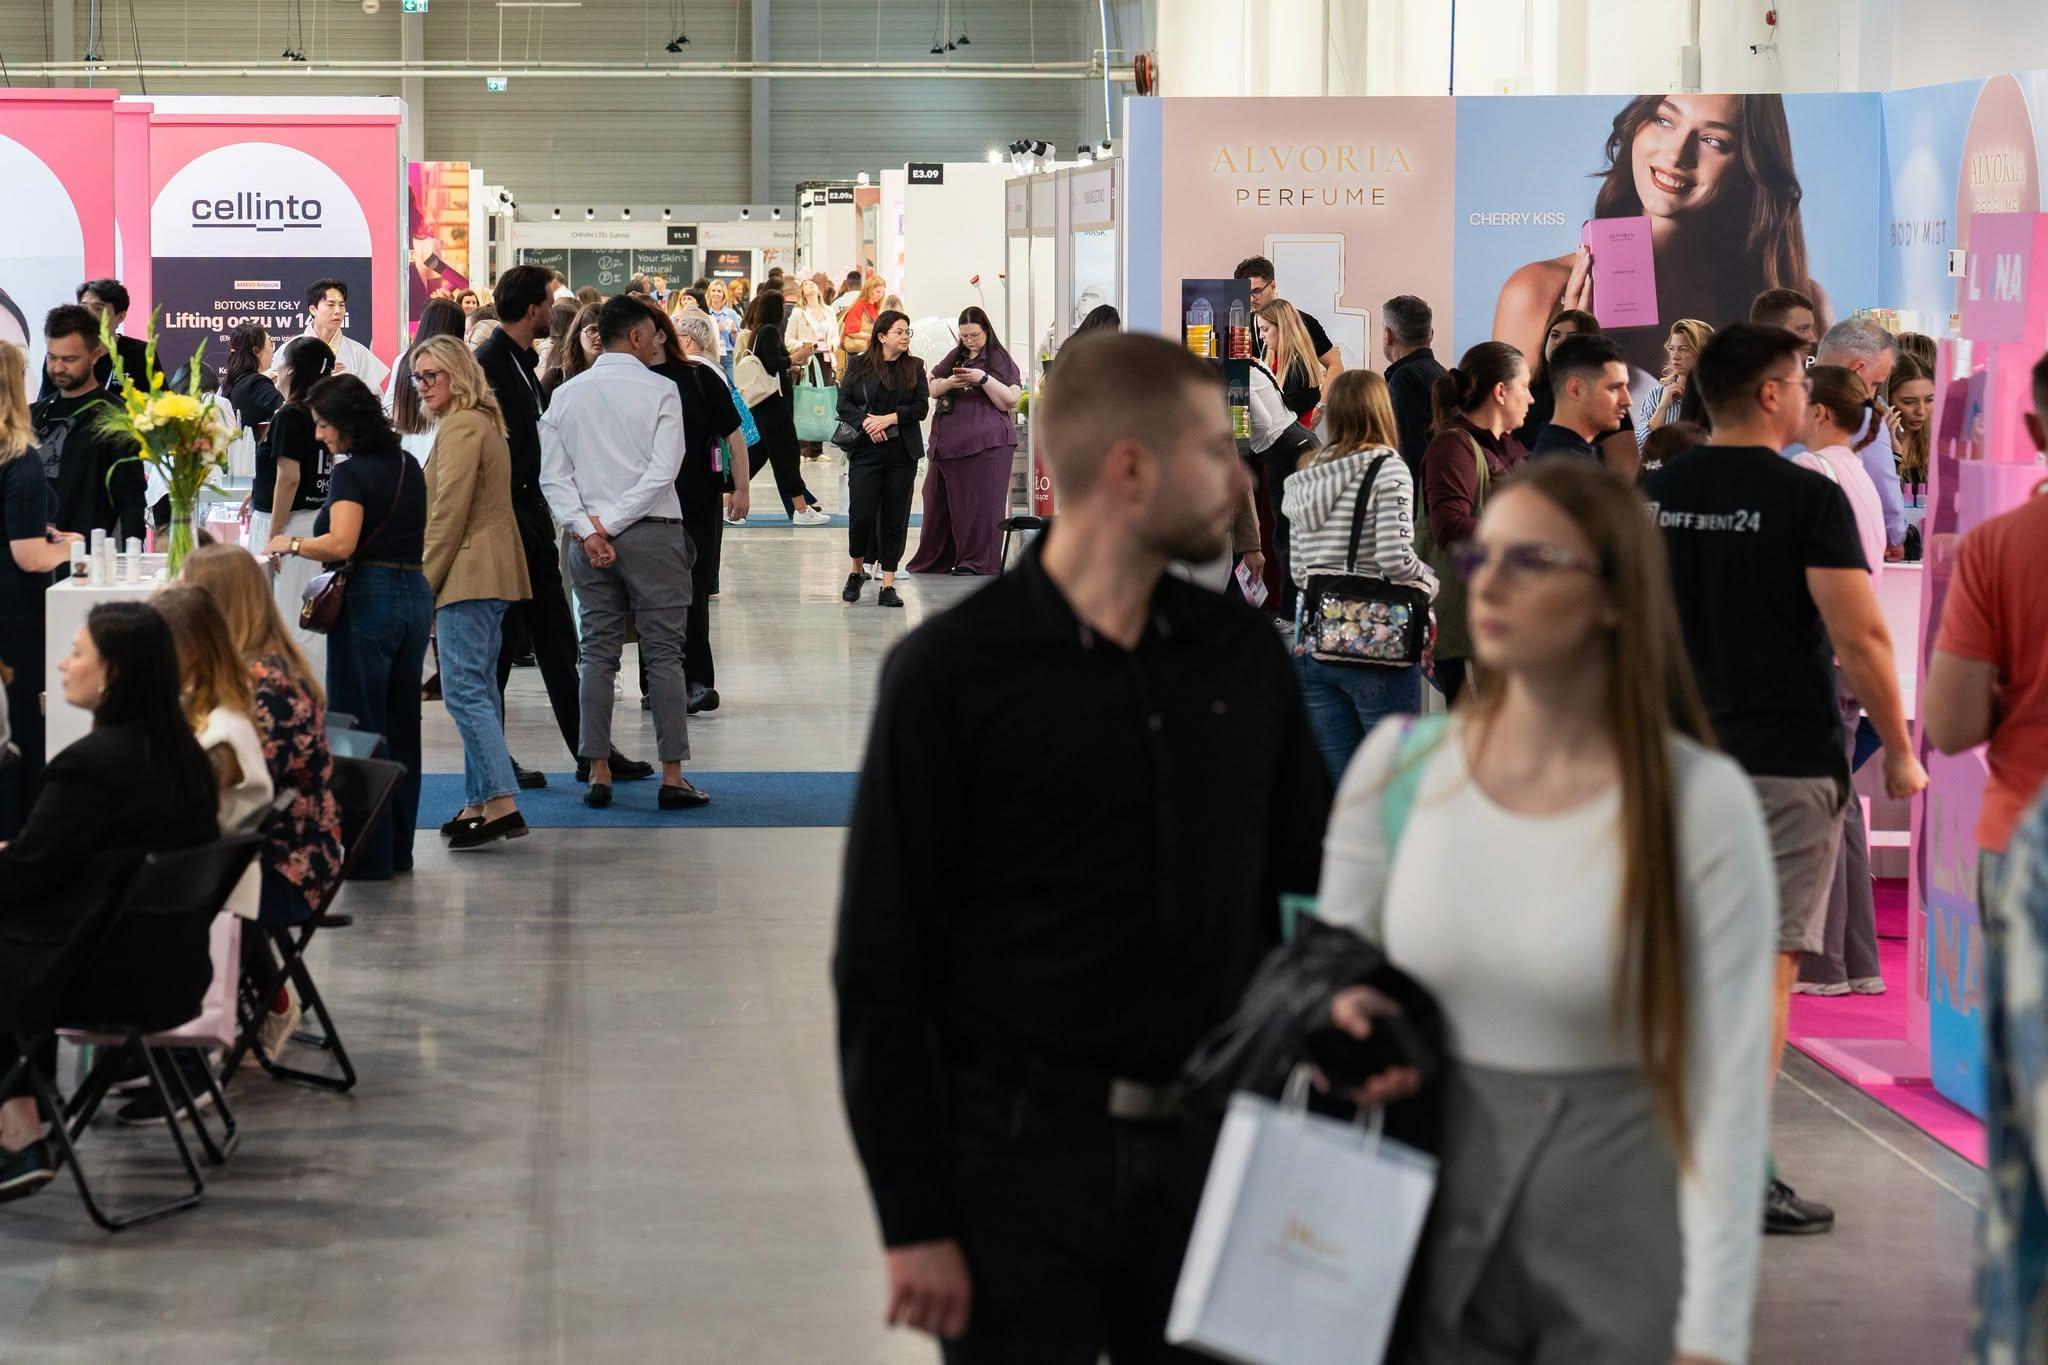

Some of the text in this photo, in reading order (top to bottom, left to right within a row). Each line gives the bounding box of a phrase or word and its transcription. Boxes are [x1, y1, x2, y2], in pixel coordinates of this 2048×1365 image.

[1210, 145, 1412, 174] ALVORIA
[912, 169, 939, 178] E3.09
[1970, 153, 2024, 185] ALVORIA
[191, 192, 322, 220] cellinto
[1236, 188, 1385, 206] PERFUME
[1469, 211, 1565, 226] CHERRY KISS
[1891, 219, 1946, 247] BODY MIST
[636, 253, 689, 262] Your Skin's
[637, 264, 673, 273] Natural
[214, 301, 301, 311] BOTOKS BEZ IGŁY
[165, 312, 224, 332] Lifting
[276, 317, 292, 328] w
